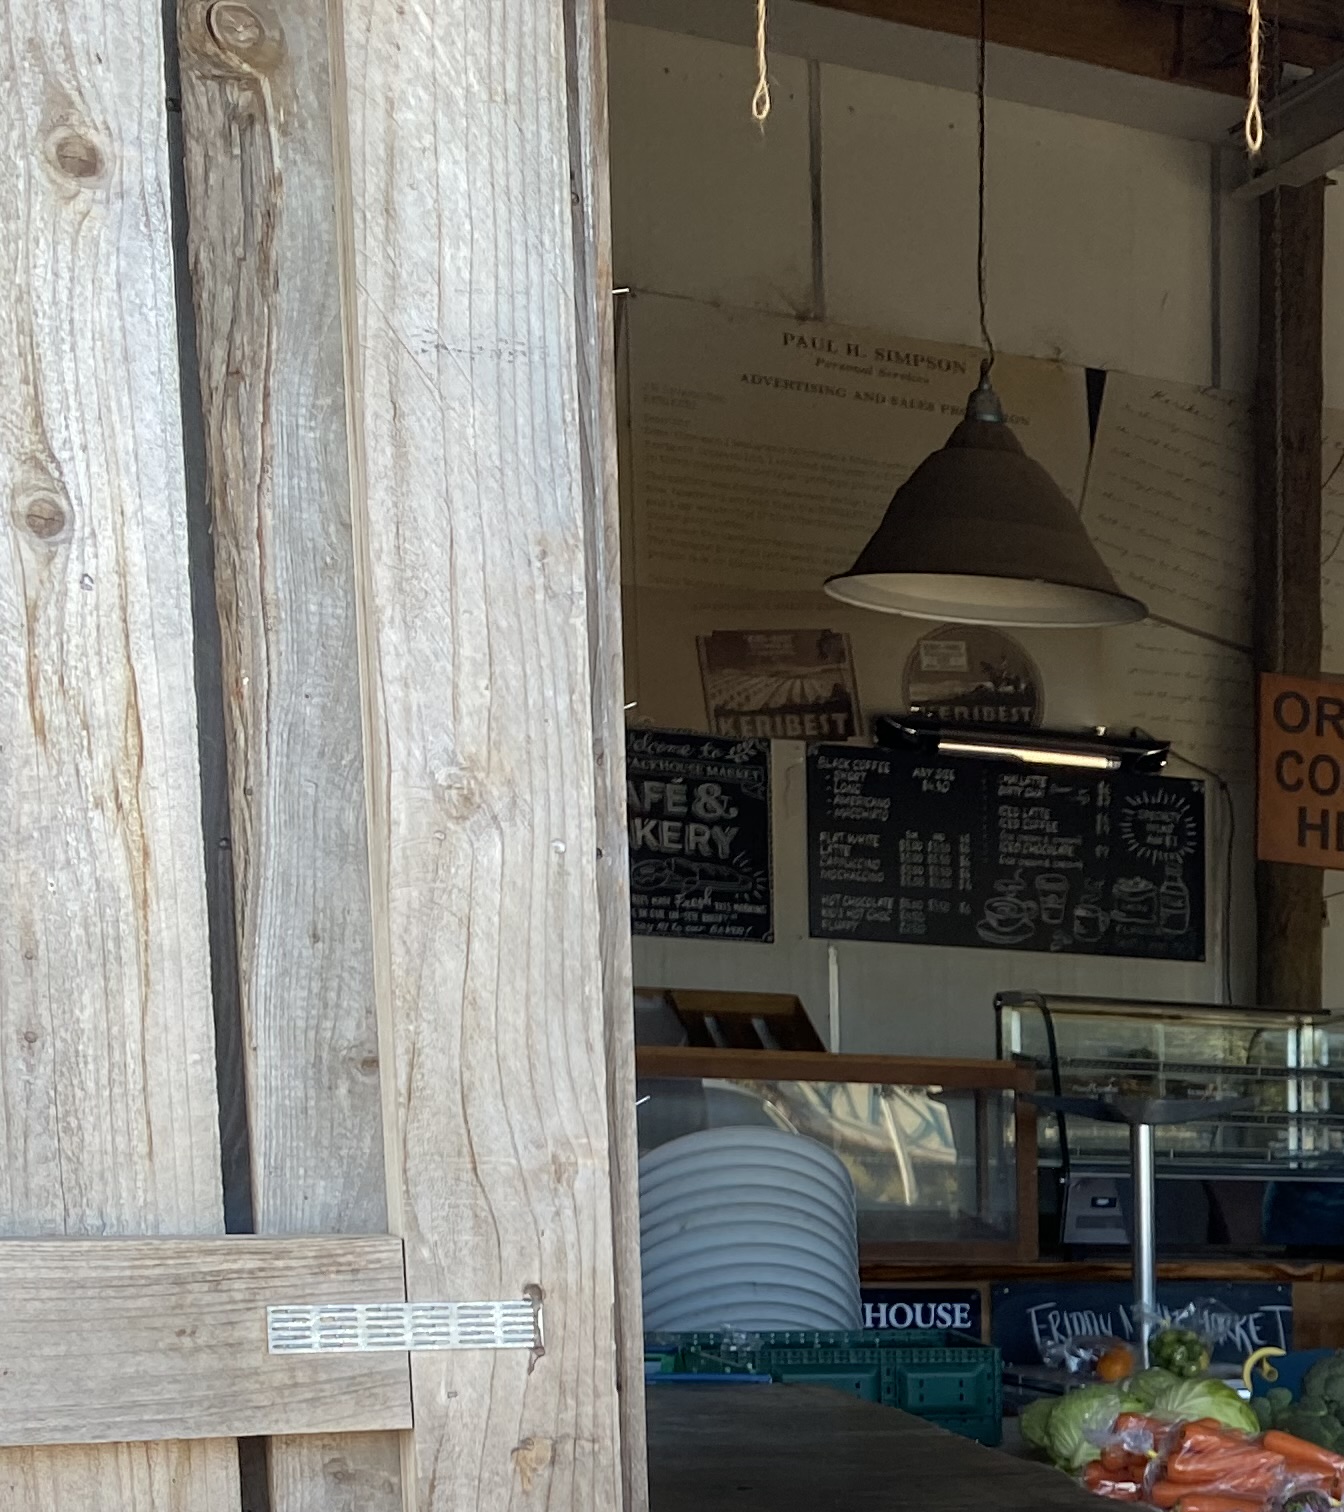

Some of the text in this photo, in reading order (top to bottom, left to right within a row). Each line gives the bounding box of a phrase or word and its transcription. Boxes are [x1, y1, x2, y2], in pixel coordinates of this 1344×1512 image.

[783, 332, 837, 356] PAUL
[874, 347, 967, 375] SIMPSON
[739, 373, 848, 399] ADVERTISING
[852, 389, 886, 405] AND
[718, 712, 849, 737] KERIBEST
[705, 764, 760, 782] MARKET
[852, 759, 891, 774] COFFEE
[691, 782, 740, 822] &
[862, 1302, 972, 1329] HOUSE
